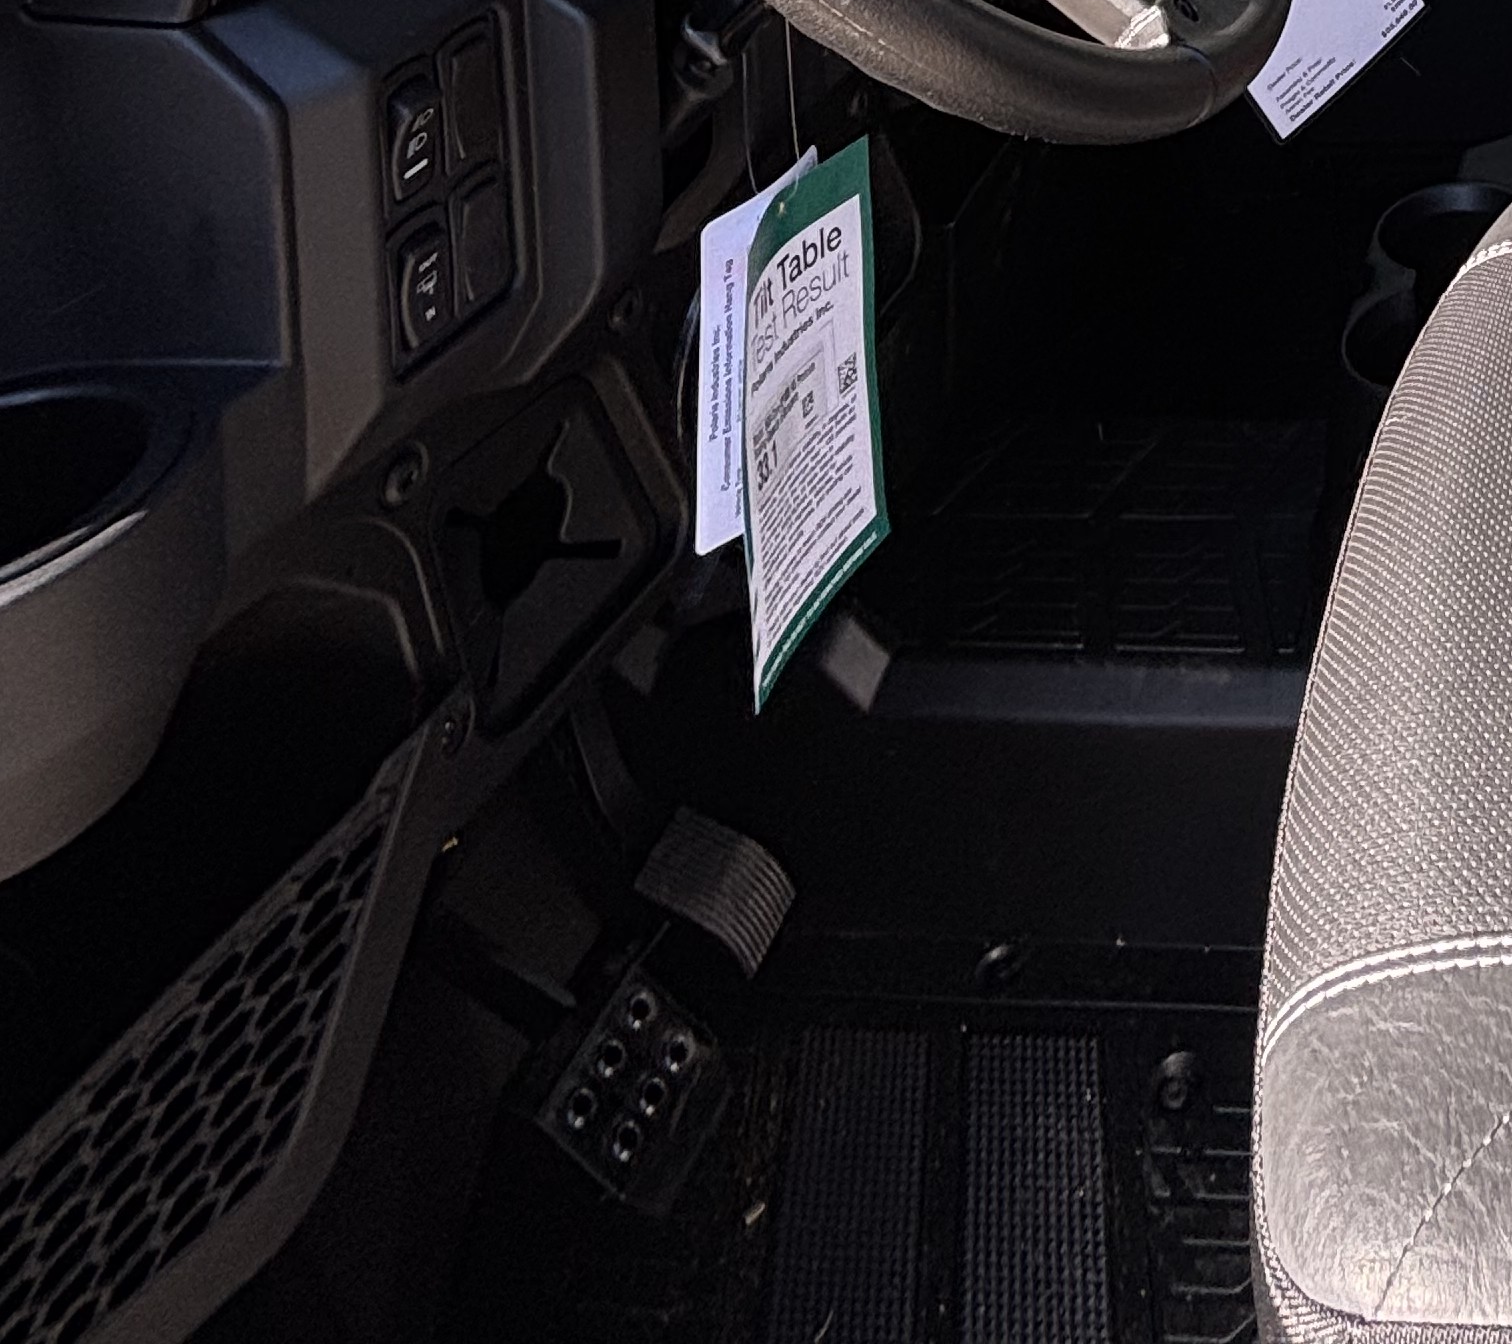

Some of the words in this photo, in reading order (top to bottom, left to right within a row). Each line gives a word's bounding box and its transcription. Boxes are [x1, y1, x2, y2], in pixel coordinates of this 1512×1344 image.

[1314, 78, 1336, 100] Retail
[751, 314, 777, 371] Test
[782, 250, 850, 329] Result
[753, 278, 774, 329] Tilt
[776, 226, 842, 289] Table
